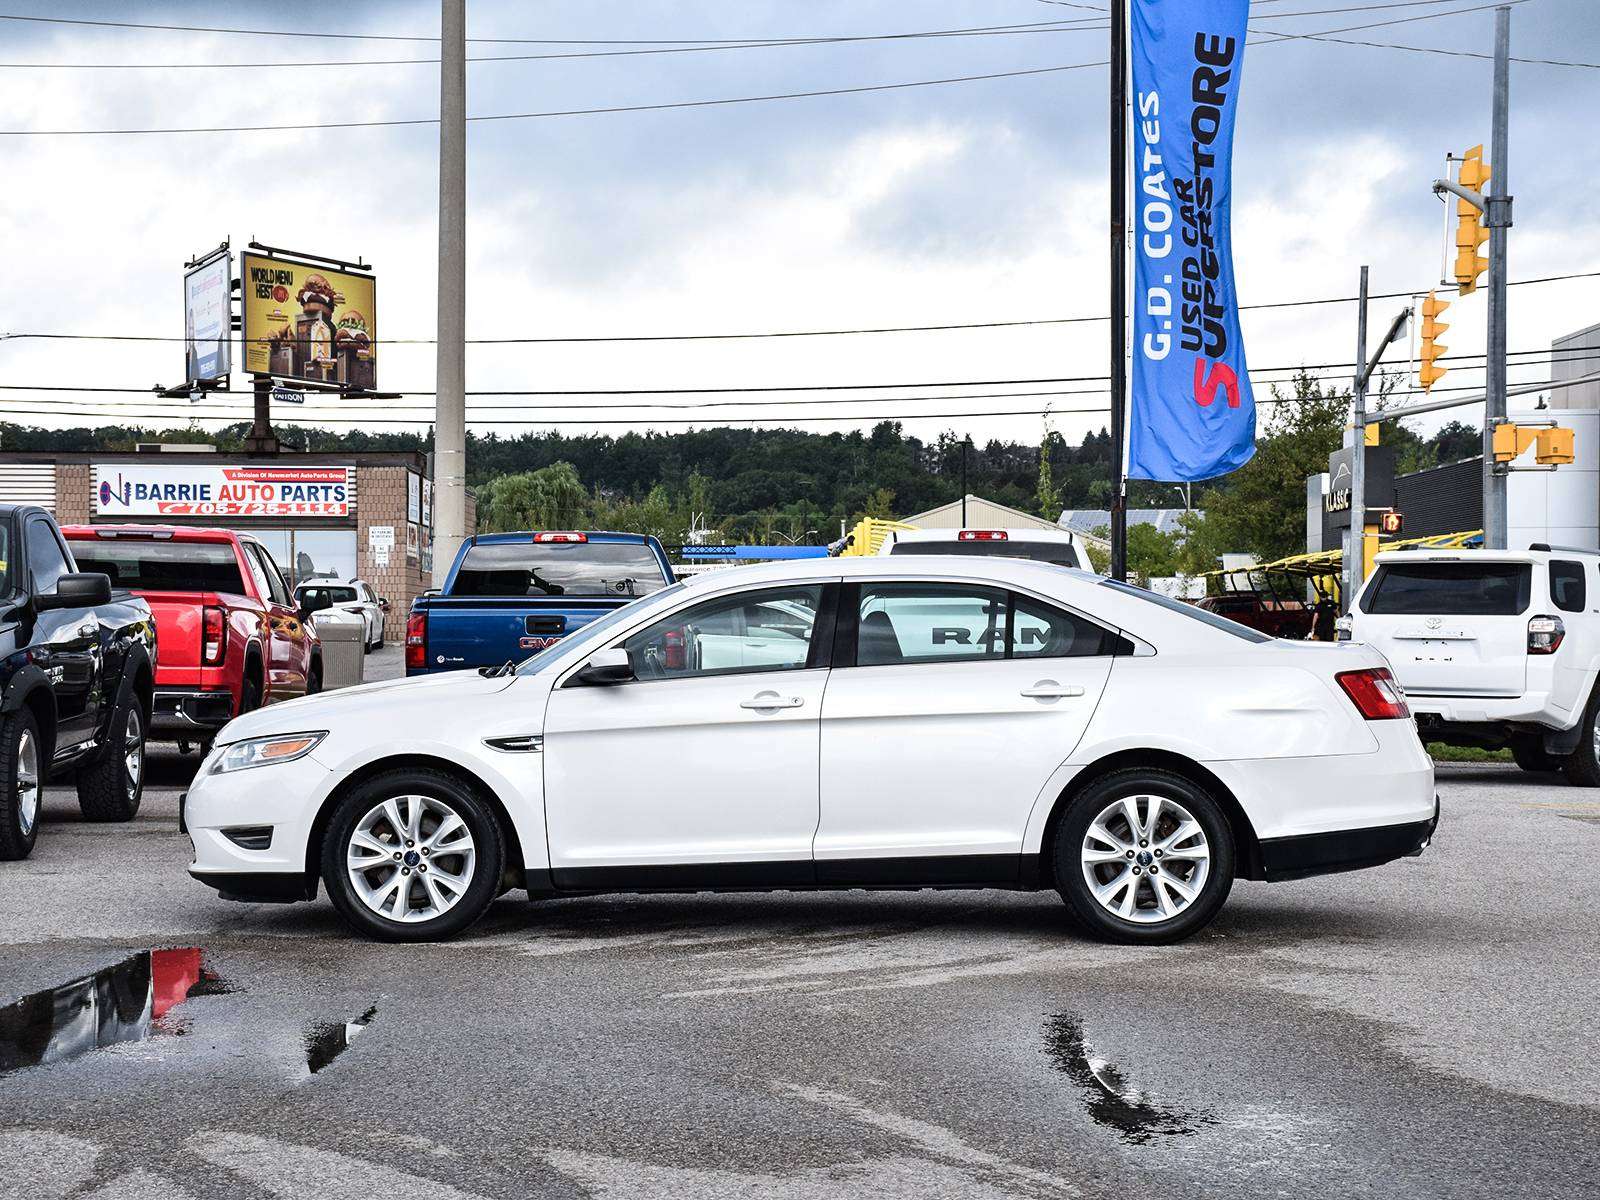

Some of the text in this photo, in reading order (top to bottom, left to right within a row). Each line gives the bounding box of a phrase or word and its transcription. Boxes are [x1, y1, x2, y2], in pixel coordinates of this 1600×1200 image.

[1138, 90, 1173, 361] G.D. COATES
[1173, 177, 1203, 352] USED CAR
[250, 266, 294, 286] WORLD MENU
[328, 472, 345, 480] Group
[135, 483, 346, 502] BARRIE AUTO PARTS
[189, 503, 344, 514] 705-725-1114
[931, 627, 1052, 645] RAM
